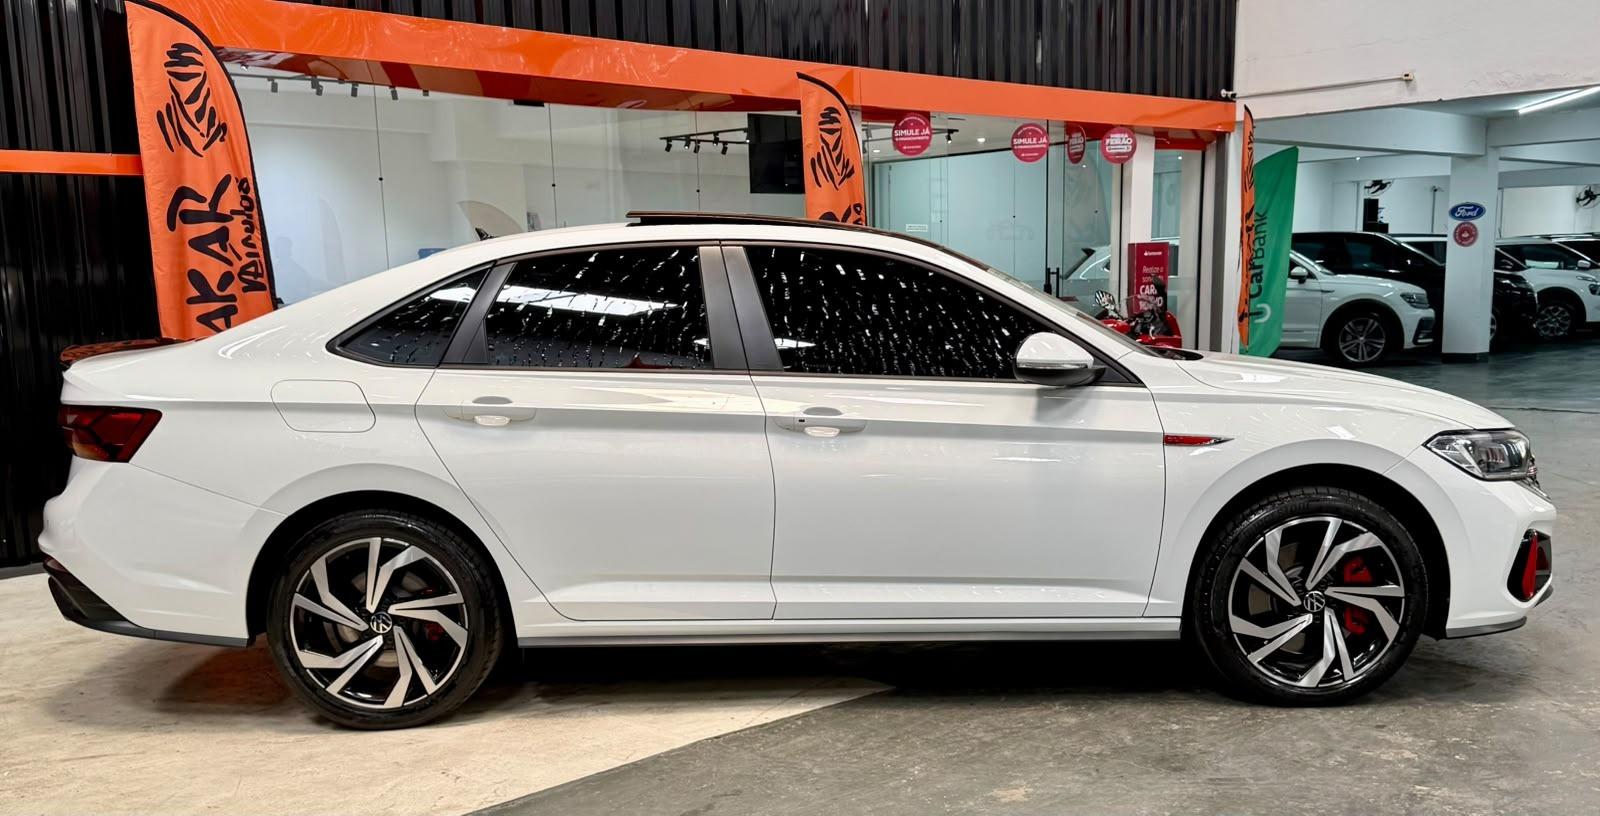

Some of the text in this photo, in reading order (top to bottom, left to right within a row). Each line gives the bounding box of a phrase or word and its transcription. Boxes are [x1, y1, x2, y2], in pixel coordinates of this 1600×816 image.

[894, 127, 930, 137] SIMULE JÁ
[1013, 135, 1047, 145] SIMULE JÁ
[1454, 205, 1480, 217] Ford
